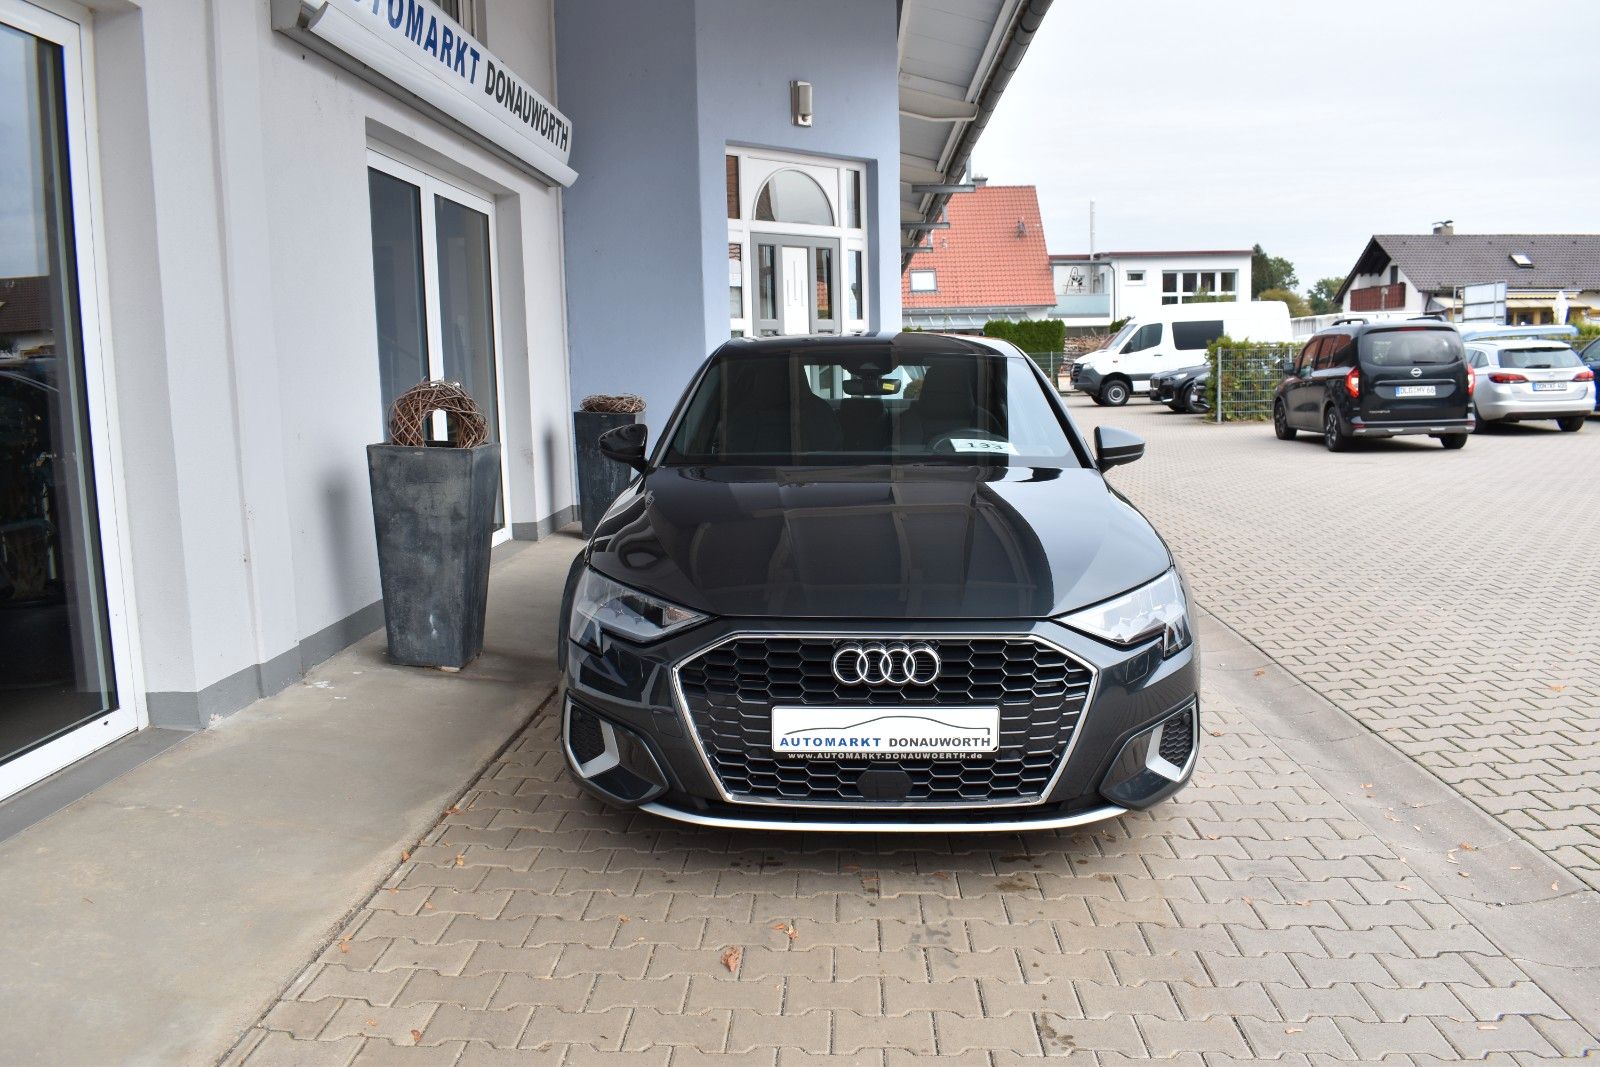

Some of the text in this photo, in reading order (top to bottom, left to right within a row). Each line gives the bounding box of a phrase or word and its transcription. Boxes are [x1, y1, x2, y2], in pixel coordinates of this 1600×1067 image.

[353, 0, 569, 153] OMARKT DONAUWÖRTH
[779, 736, 991, 748] AUTOMARKT DONAUWÖRTH
[787, 752, 984, 760] www.AUTOMARKT-DONAUWOERTH.de
